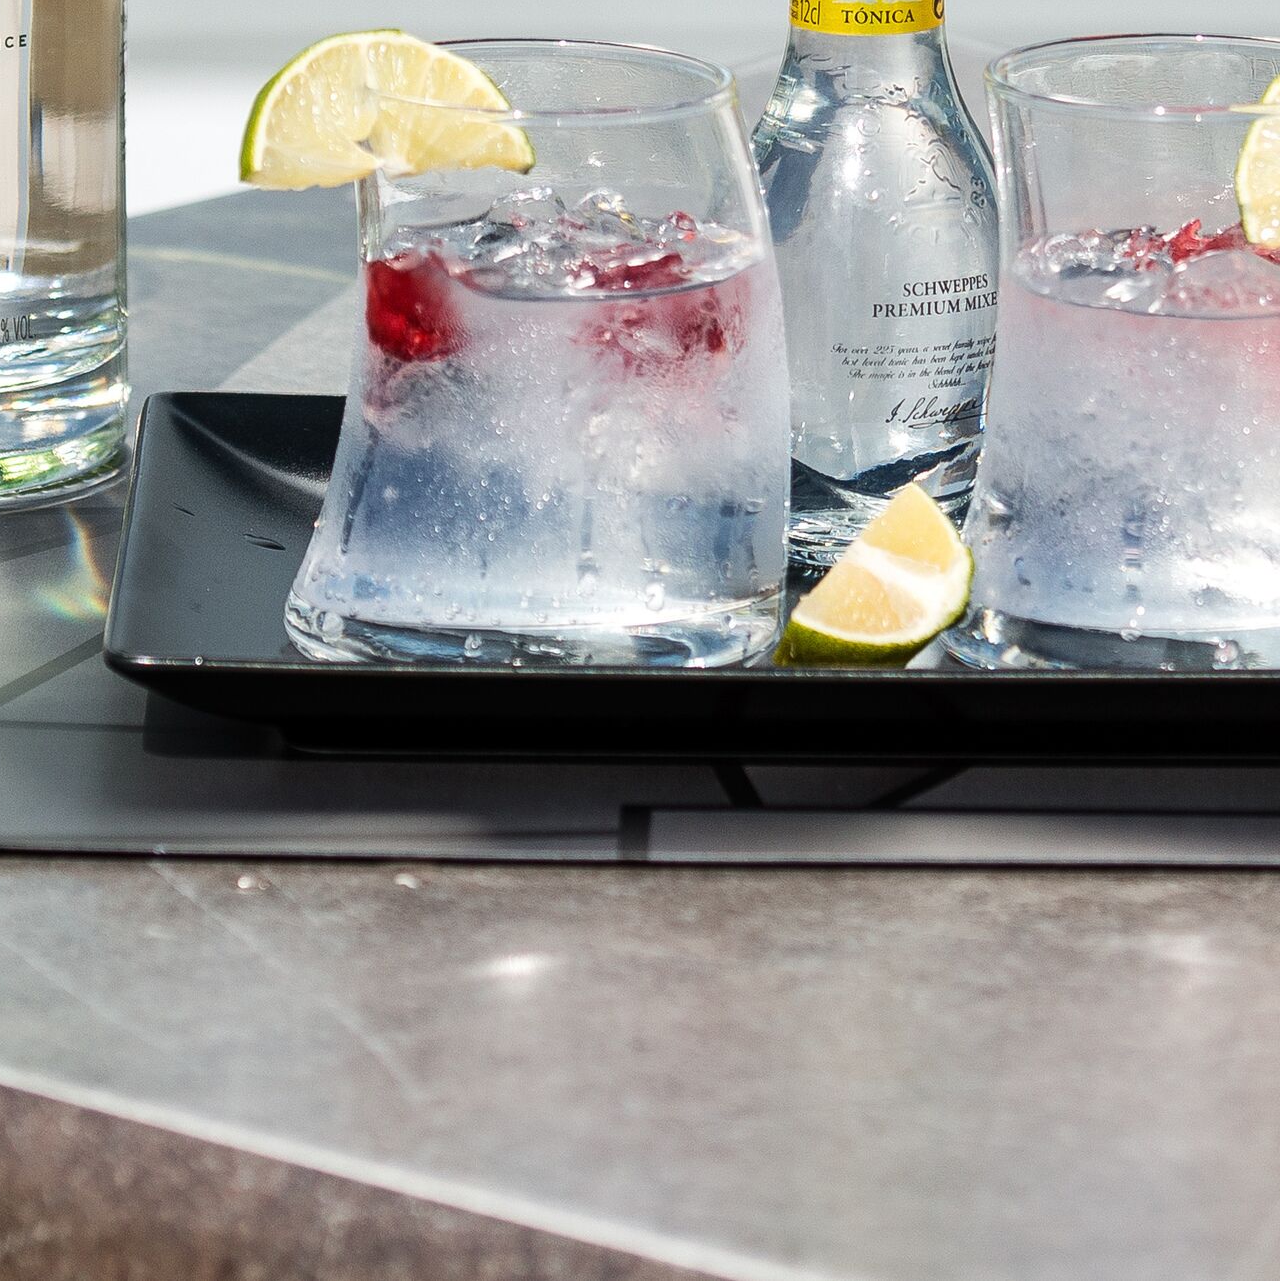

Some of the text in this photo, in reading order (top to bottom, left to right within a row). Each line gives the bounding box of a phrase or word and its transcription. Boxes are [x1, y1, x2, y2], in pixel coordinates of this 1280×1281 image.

[840, 7, 915, 25] TÓNICA
[903, 274, 988, 297] SCHWEPPES
[872, 291, 998, 318] PREMIUM MIXE
